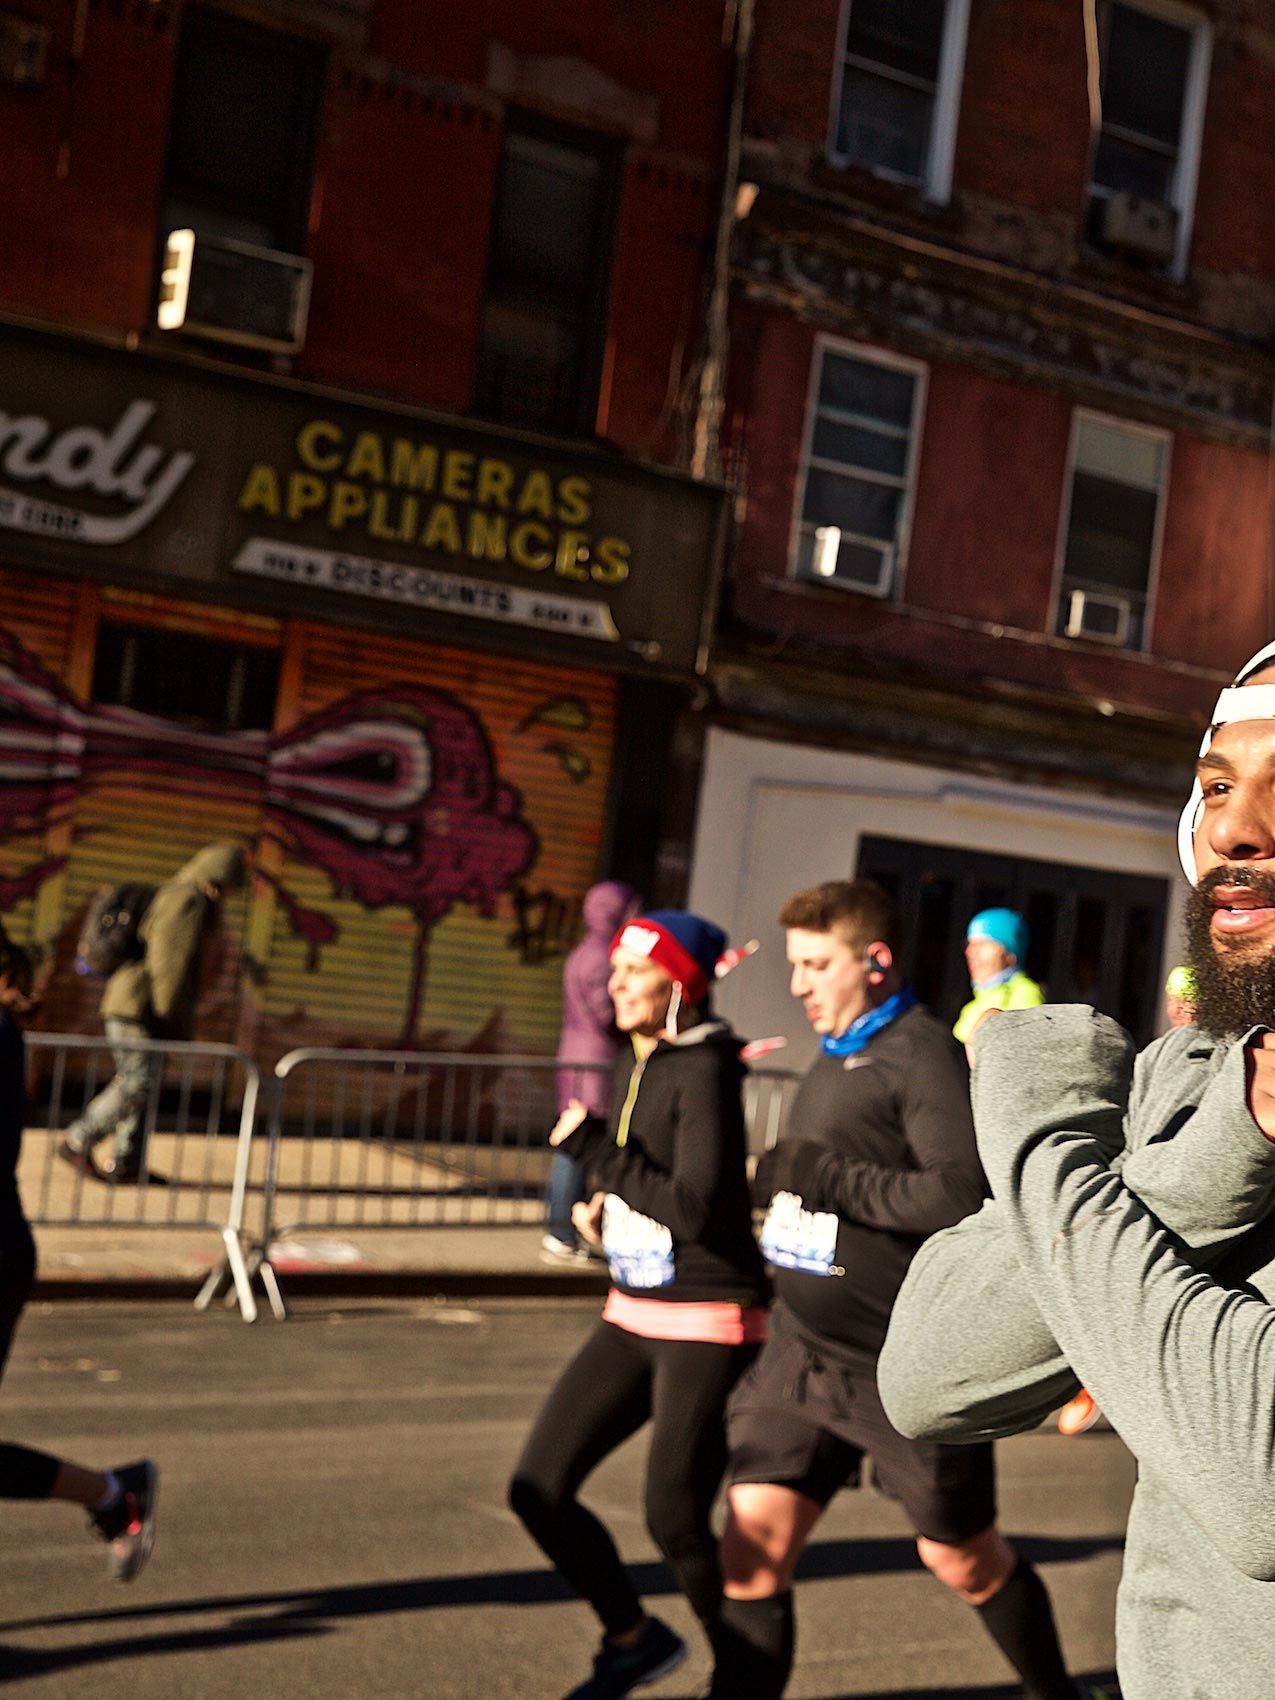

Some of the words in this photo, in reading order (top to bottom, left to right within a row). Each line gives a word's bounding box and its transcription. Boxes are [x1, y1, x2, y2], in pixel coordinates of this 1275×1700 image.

[237, 463, 632, 585] APPLIANCES
[296, 419, 592, 526] CAMERAS
[330, 556, 514, 613] DISCOUNTS
